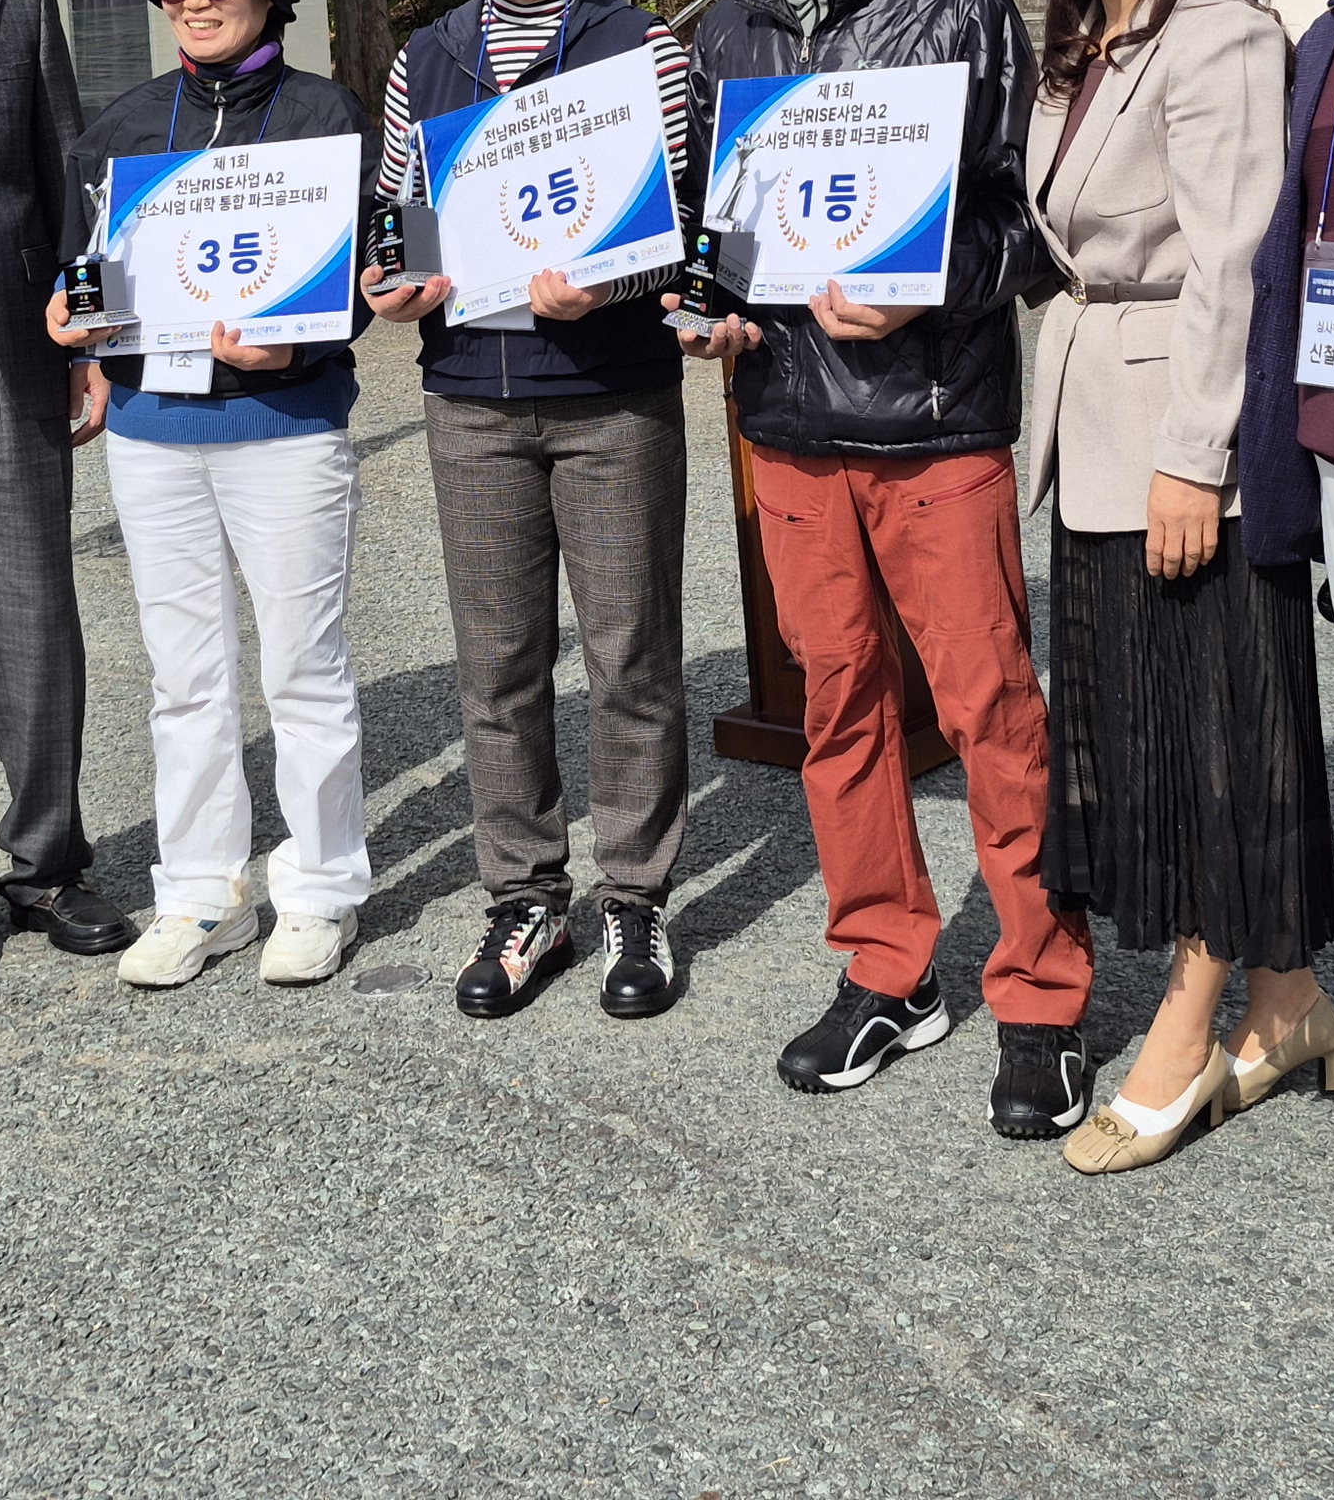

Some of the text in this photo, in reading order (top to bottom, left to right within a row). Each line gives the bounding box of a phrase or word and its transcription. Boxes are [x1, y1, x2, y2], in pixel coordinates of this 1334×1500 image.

[857, 59, 883, 69] K2
[483, 98, 587, 147] 전남RISE사업 A2
[780, 103, 888, 126] 전남RISE사업 A2
[450, 103, 632, 180] 컨소시엄 대학 통합 파크골프대회
[793, 130, 818, 148] 대학
[820, 127, 847, 147] 통합
[850, 123, 930, 145] 파크골프대회
[175, 171, 286, 196] 전남RISE사업 A2
[134, 185, 329, 219] 컨소시엄 대학 통합 파크골프대회
